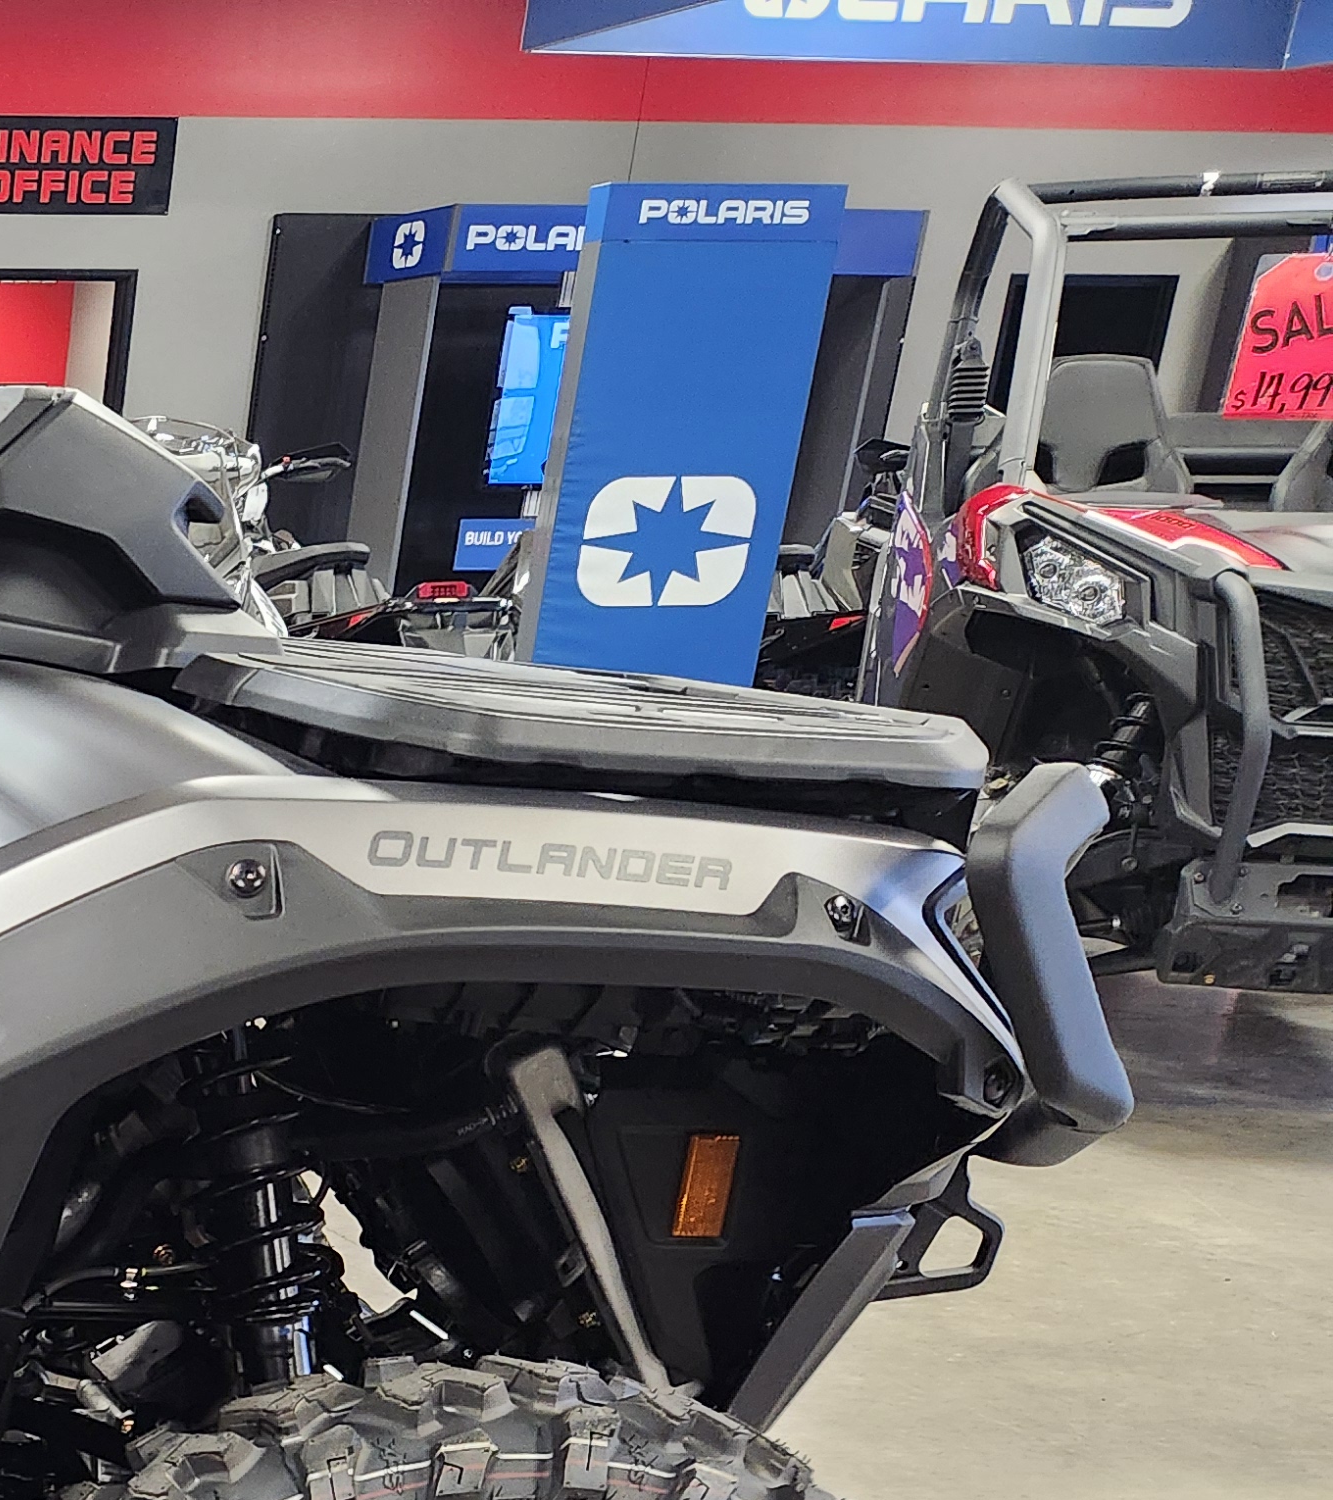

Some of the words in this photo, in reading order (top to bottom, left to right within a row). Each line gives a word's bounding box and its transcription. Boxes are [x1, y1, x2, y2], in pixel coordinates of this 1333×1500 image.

[638, 199, 810, 225] POLARIS
[465, 224, 585, 251] POLA
[1251, 293, 1333, 354] SAL
[464, 530, 504, 546] BUILD
[367, 830, 733, 891] OUTLANDER
